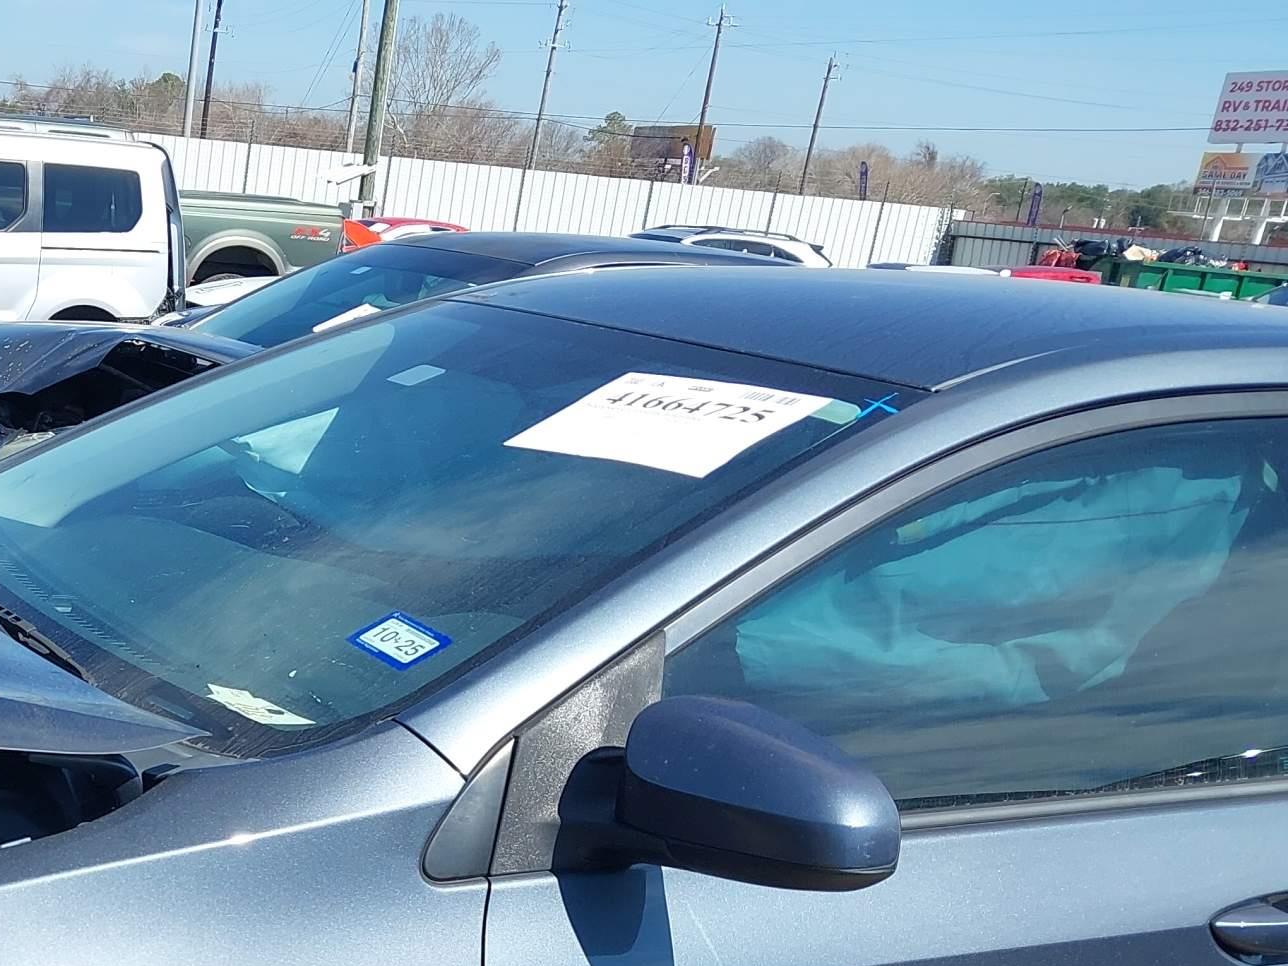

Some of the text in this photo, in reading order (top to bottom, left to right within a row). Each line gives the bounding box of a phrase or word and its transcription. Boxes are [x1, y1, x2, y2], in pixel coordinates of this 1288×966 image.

[1229, 81, 1253, 93] 249
[1221, 99, 1288, 112] RV & TRAI
[605, 391, 775, 423] 41664725
